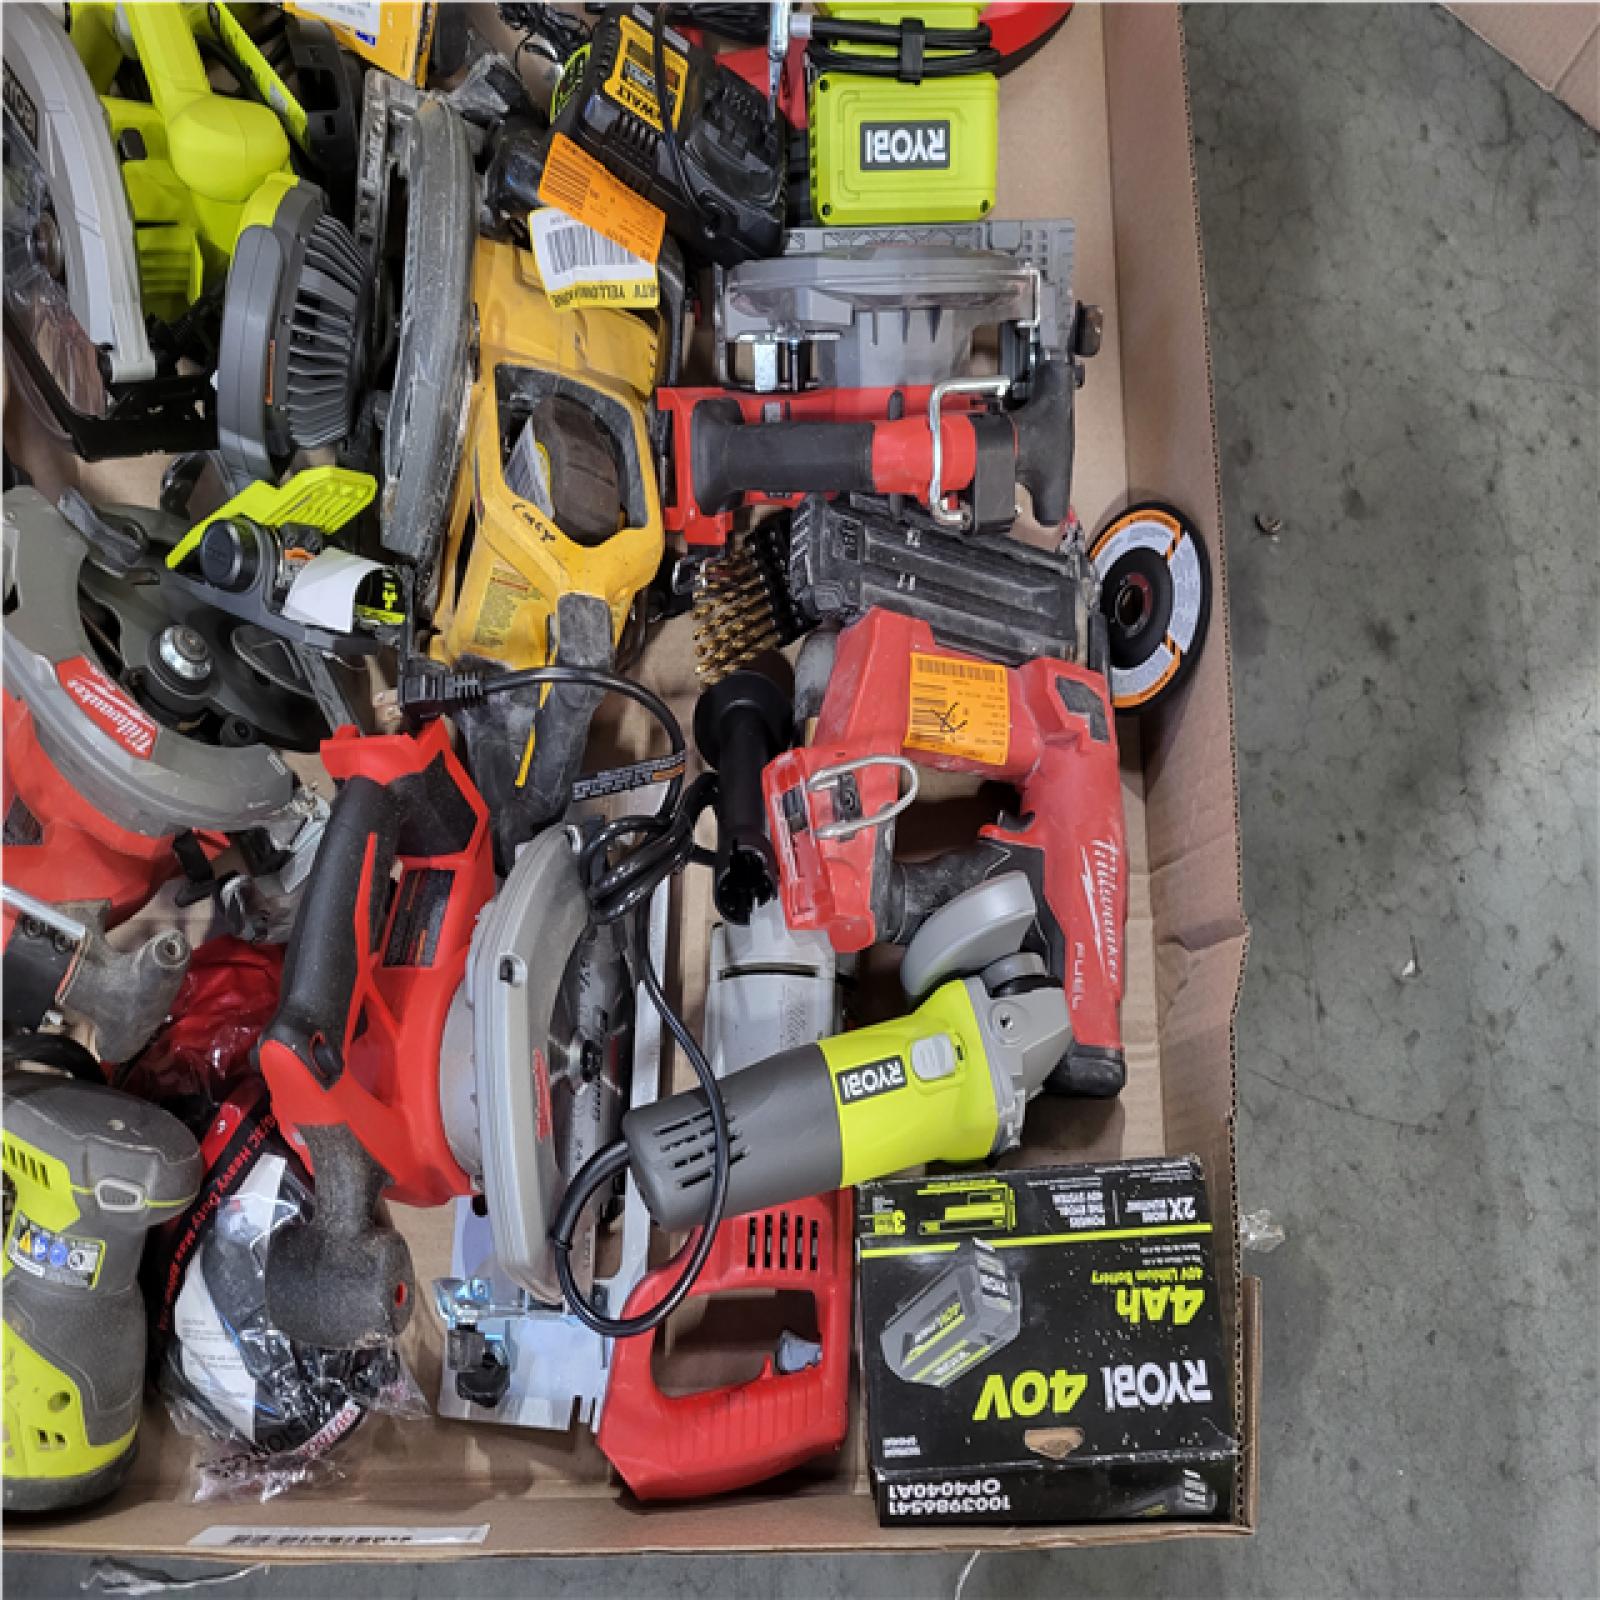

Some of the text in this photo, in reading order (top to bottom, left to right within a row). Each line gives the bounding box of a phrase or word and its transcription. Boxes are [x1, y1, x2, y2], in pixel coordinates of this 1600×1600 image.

[864, 129, 946, 164] RYOBI
[1090, 839, 1119, 984] Milwaukee
[1072, 941, 1086, 1011] FUEL
[842, 1060, 904, 1101] RYOBI
[1168, 1197, 1196, 1222] 2X
[1115, 1284, 1205, 1326] 4Ah
[972, 1359, 1212, 1421] RYOBI 40V
[888, 1478, 1001, 1499] OP4040A1
